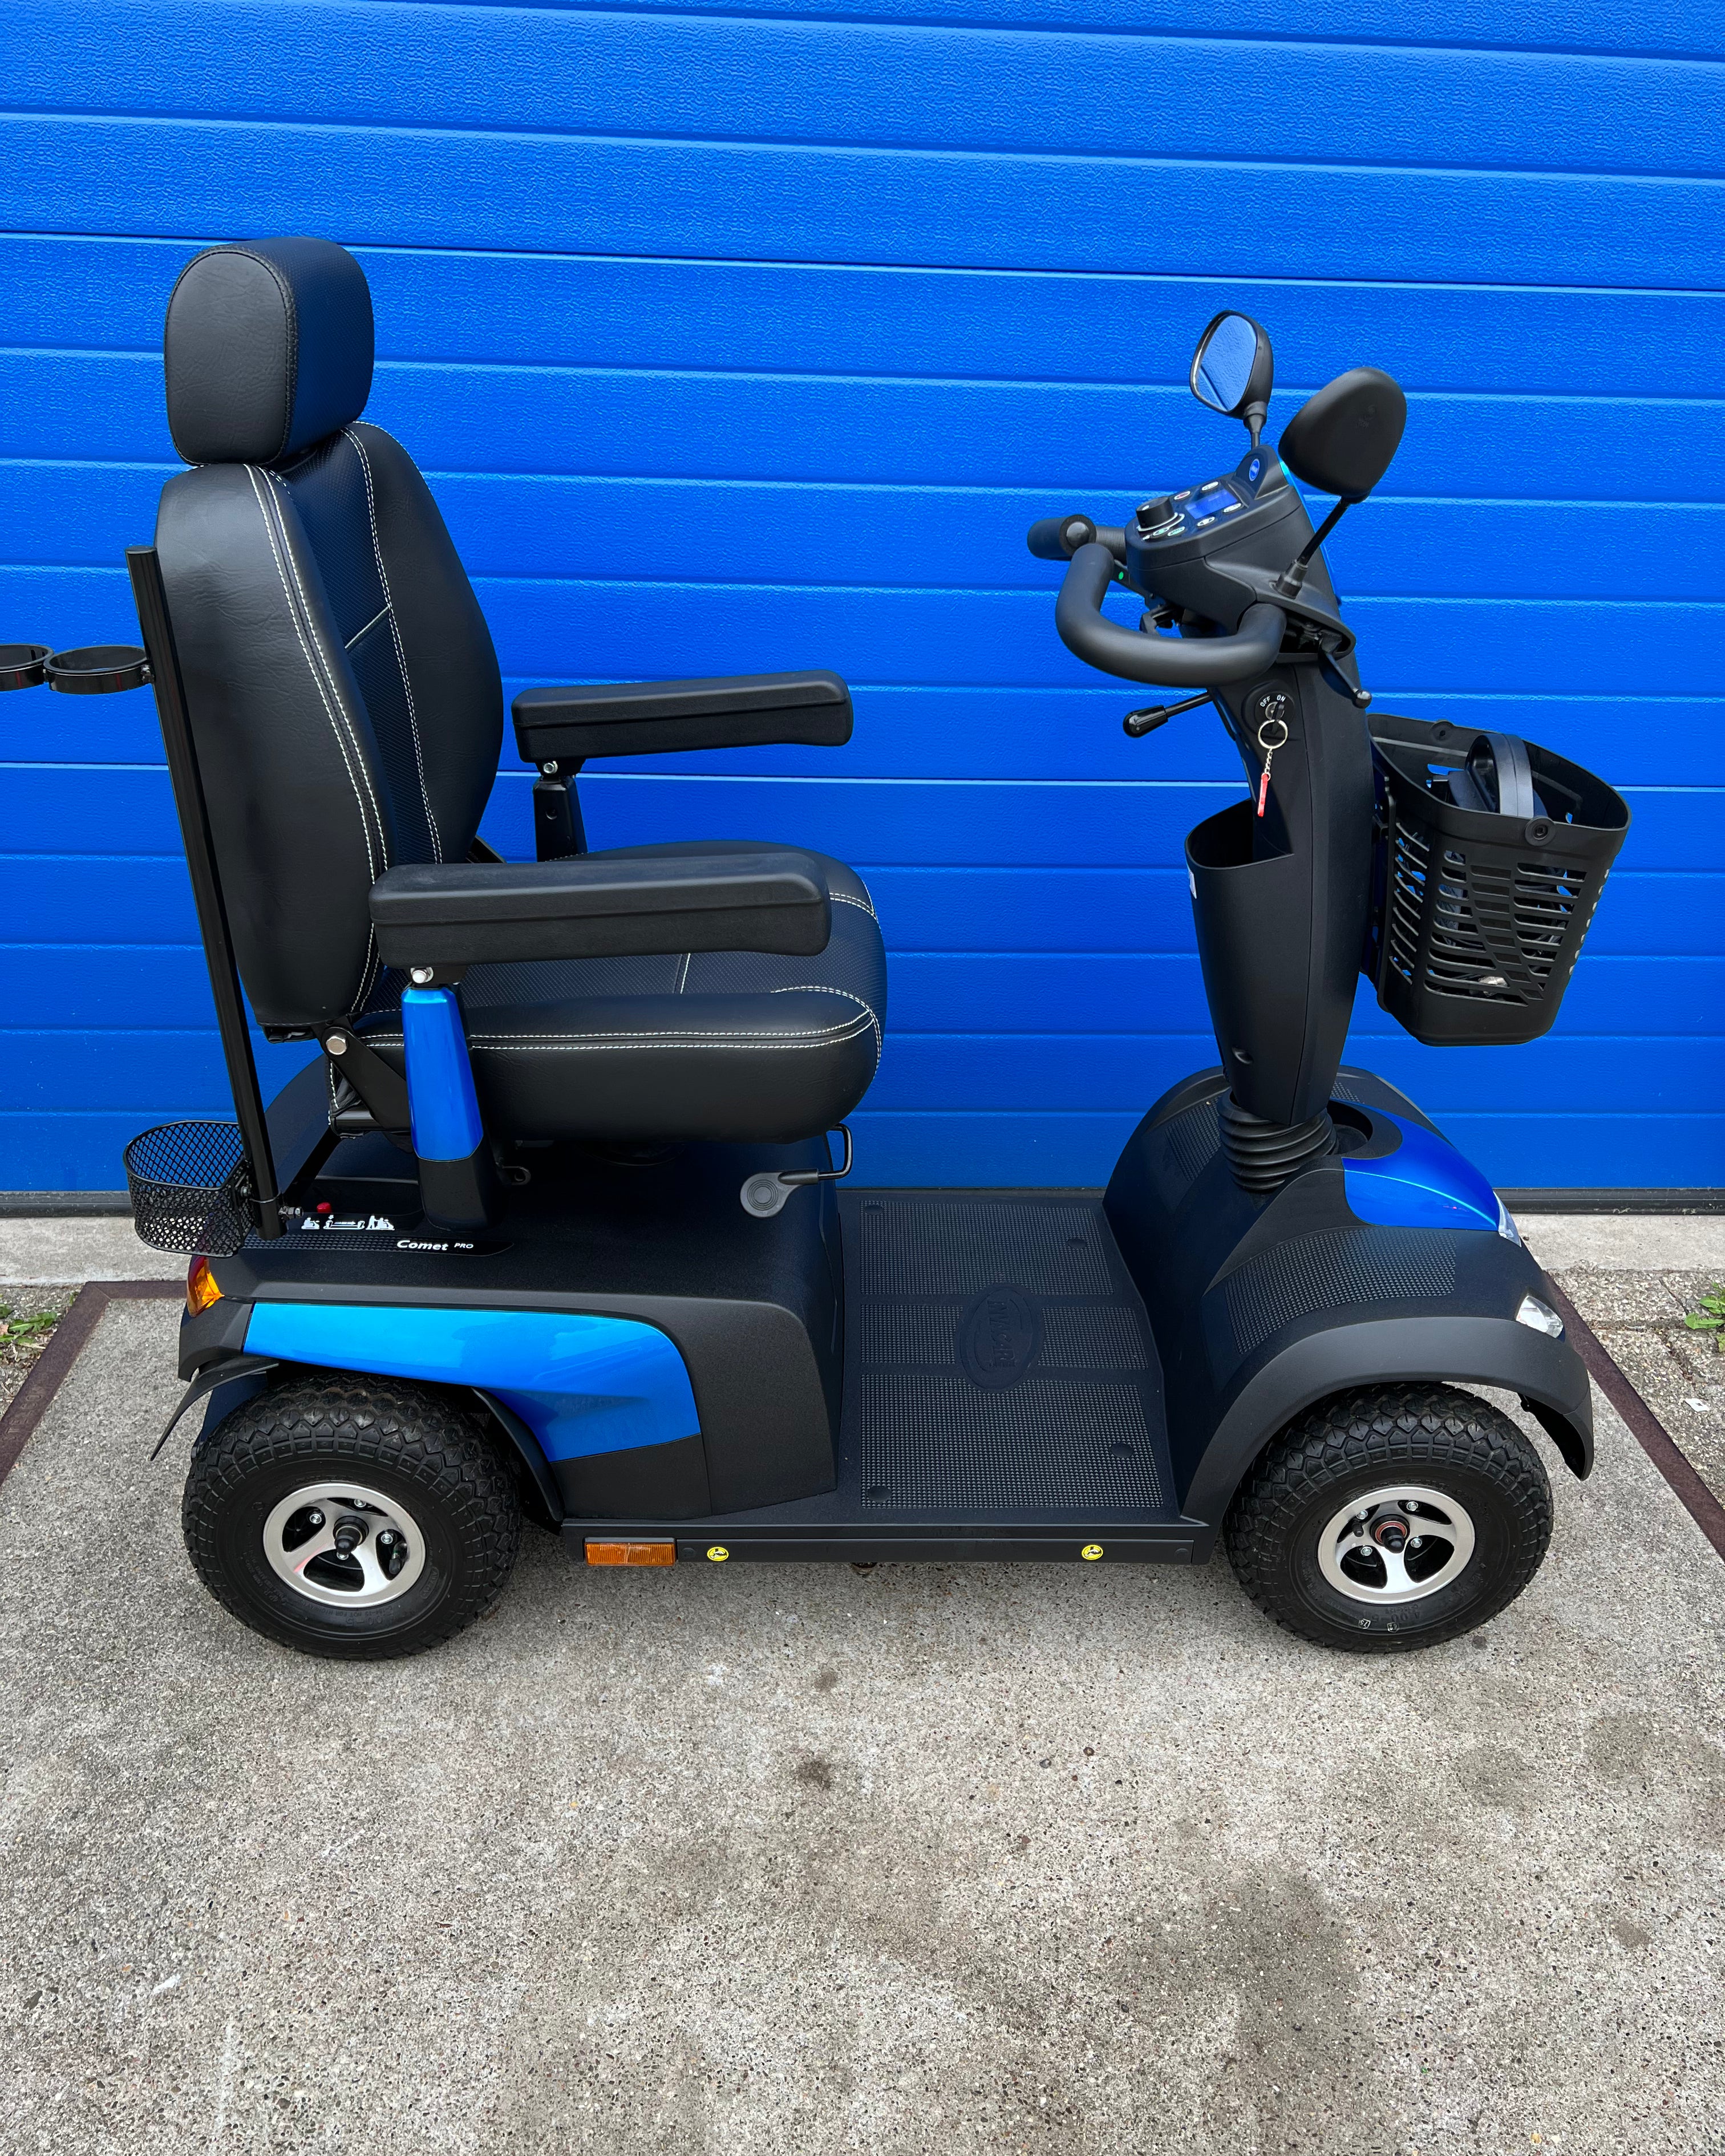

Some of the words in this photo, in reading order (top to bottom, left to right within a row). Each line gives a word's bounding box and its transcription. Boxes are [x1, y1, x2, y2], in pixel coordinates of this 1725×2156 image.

[1260, 695, 1271, 707] OFF
[1277, 694, 1286, 702] ON
[396, 1240, 449, 1251] Comet
